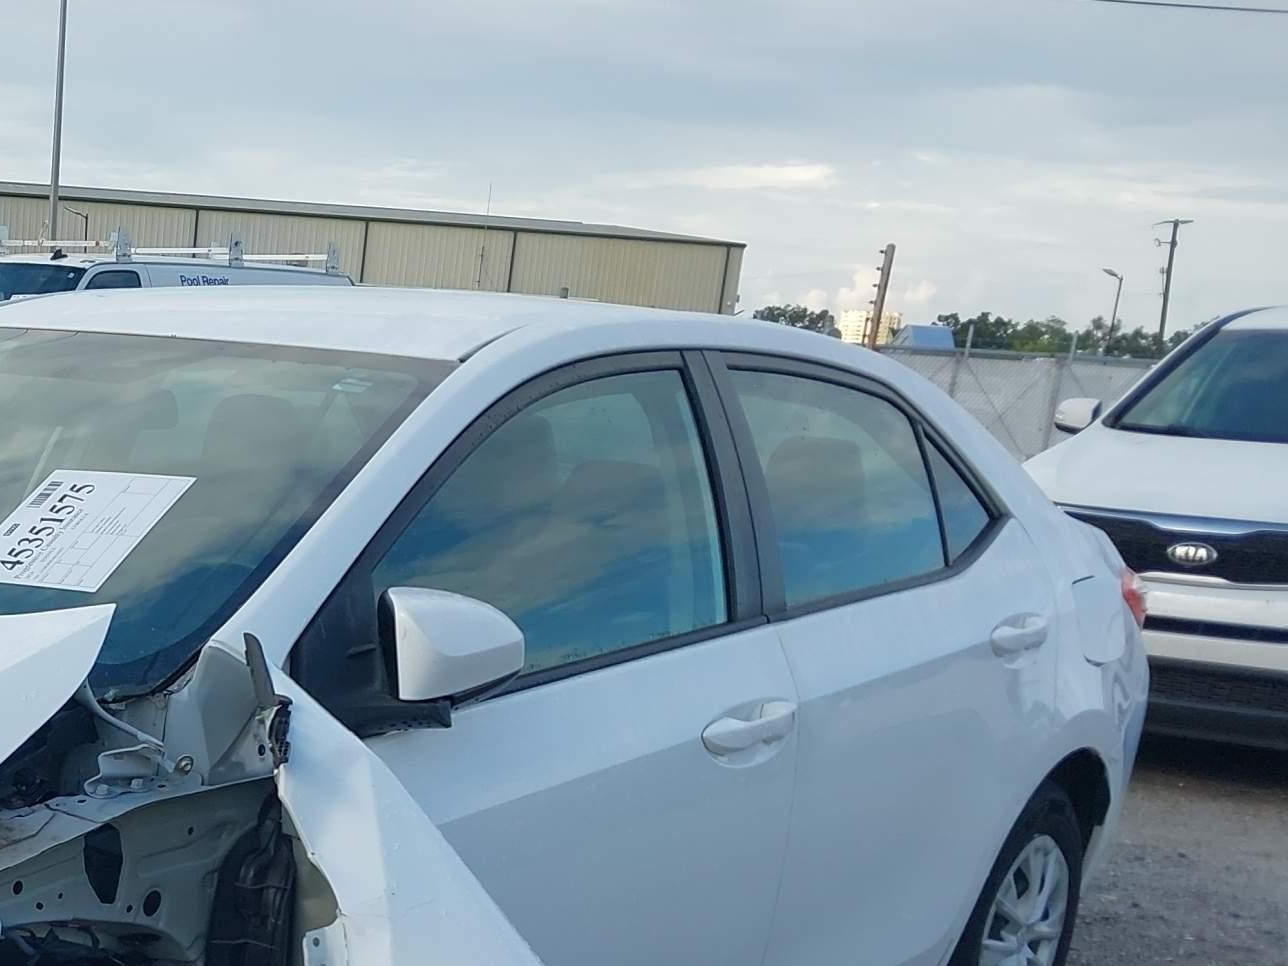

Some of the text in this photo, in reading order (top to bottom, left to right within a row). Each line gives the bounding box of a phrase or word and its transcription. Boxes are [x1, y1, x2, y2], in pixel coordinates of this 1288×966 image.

[179, 275, 230, 287] Pool Repair
[0, 483, 96, 571] 45351575
